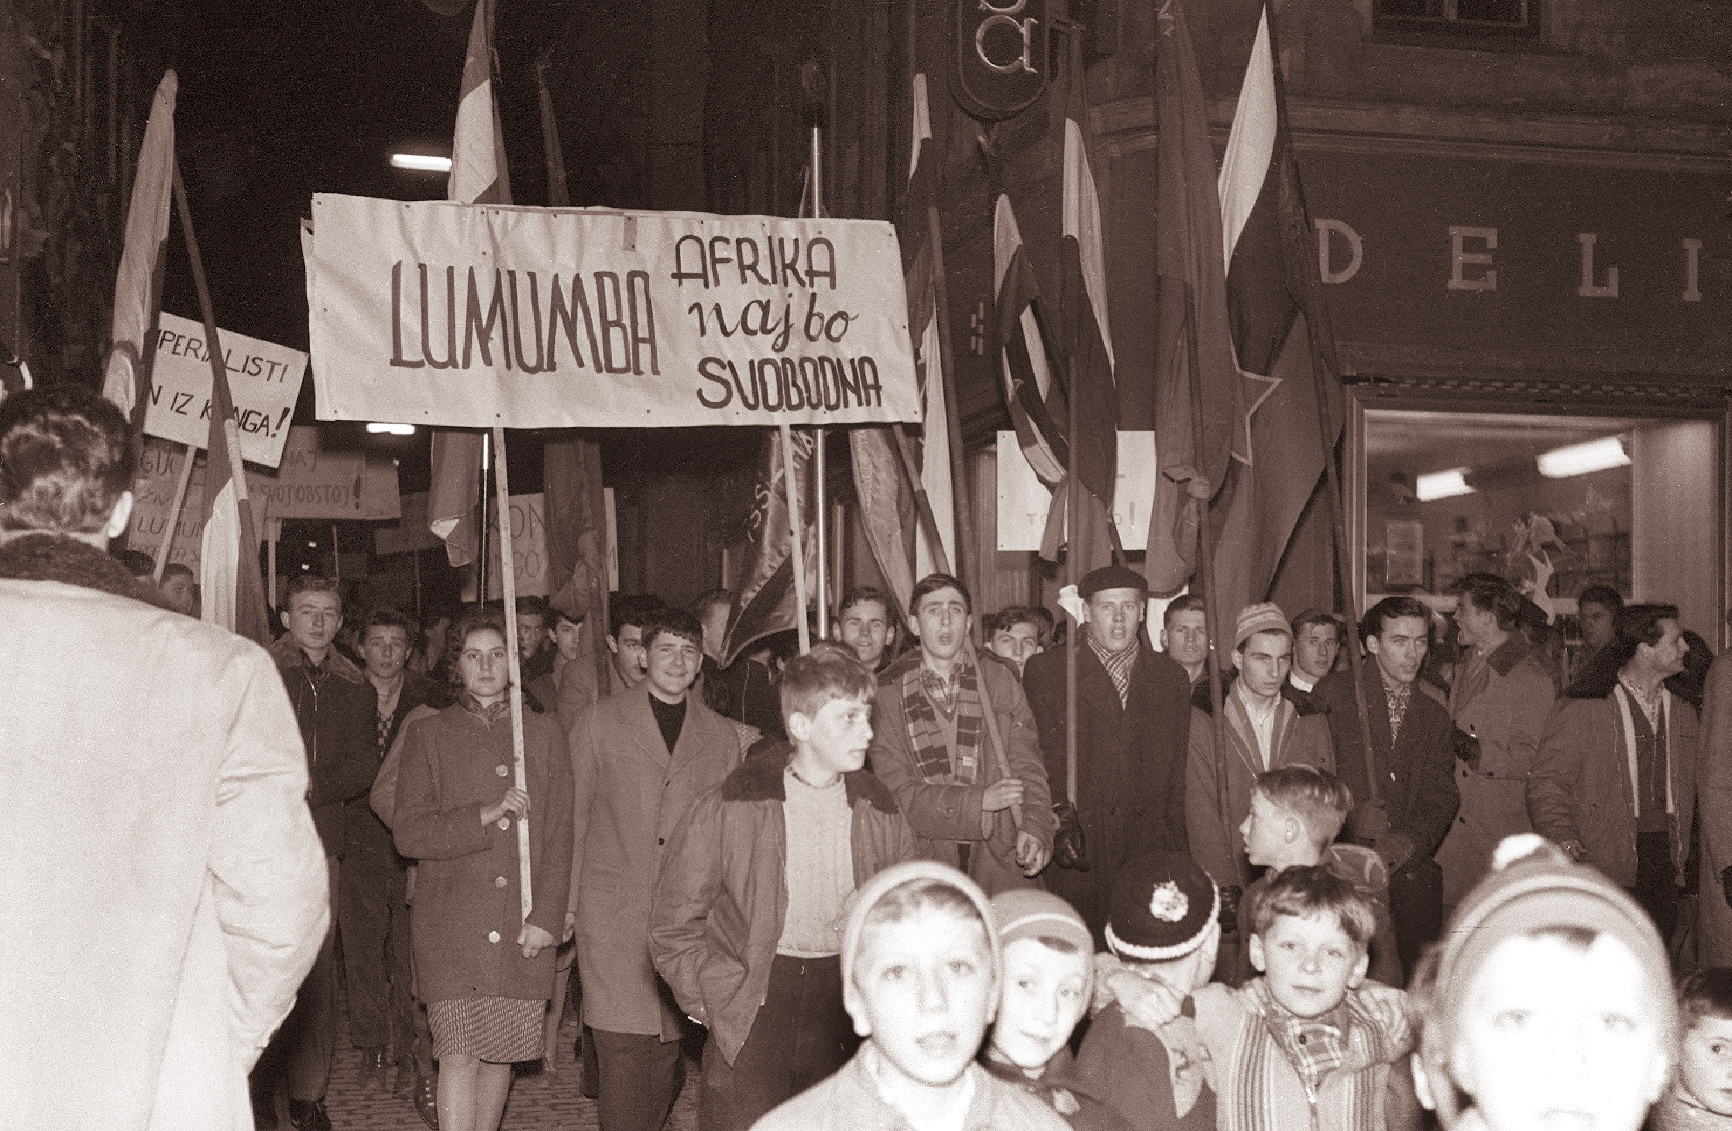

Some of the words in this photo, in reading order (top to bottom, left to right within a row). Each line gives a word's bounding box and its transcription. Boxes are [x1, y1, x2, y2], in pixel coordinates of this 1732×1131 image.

[671, 234, 836, 290] AFRIKA
[1314, 217, 1703, 301] DELI
[390, 260, 660, 376] LUMUMBA
[688, 292, 795, 353] naj
[803, 291, 860, 343] bo
[158, 329, 289, 384] PERILISTI
[697, 355, 882, 412] SVOBODNA
[170, 392, 194, 416] IZ
[200, 399, 291, 439] KNGA!
